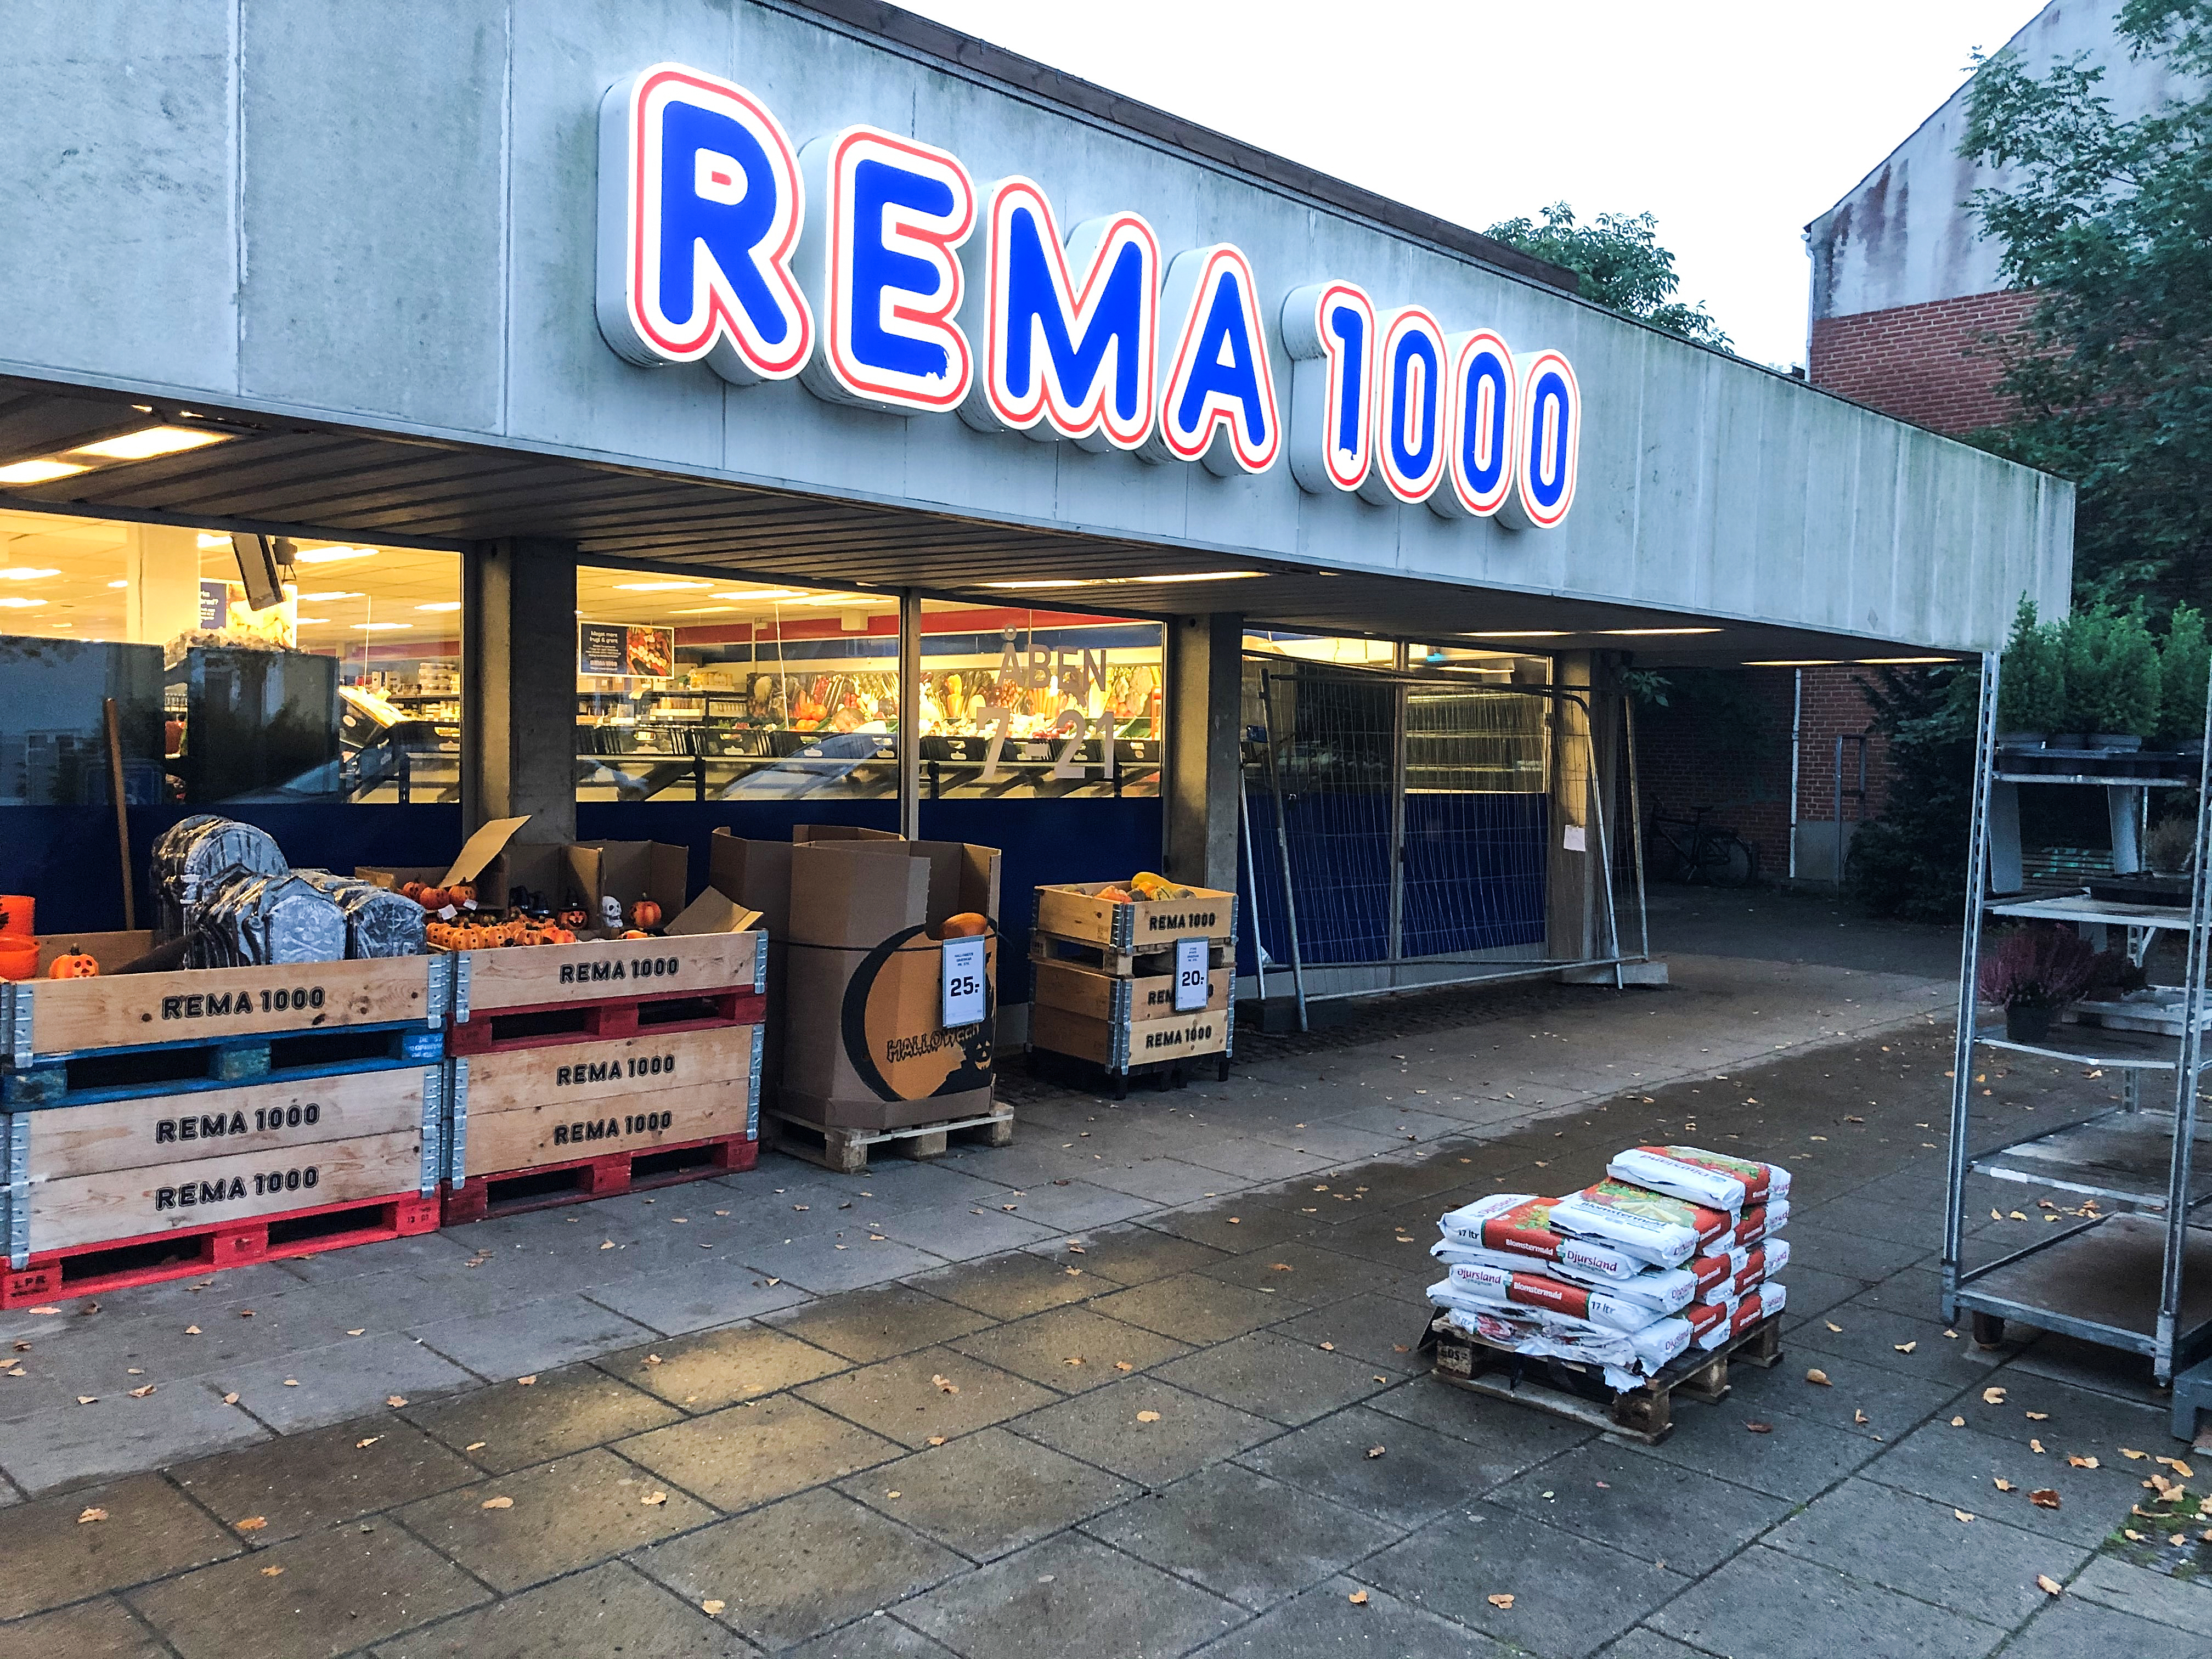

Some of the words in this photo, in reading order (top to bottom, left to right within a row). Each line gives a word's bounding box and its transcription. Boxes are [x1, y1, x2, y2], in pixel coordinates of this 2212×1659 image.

[627, 62, 1281, 474] REMA
[1316, 279, 1581, 528] 1000
[997, 624, 1107, 692] ÅBEN
[1149, 913, 1186, 931] REMA
[1189, 912, 1216, 928] 1000
[560, 960, 626, 984] REMA
[631, 957, 679, 979] 1000
[162, 991, 253, 1020] REMA
[259, 986, 325, 1013] 1000
[1146, 1029, 1182, 1049] REMA
[1185, 1025, 1212, 1043] 1000
[556, 1059, 623, 1086] REMA
[627, 1054, 675, 1078] 1000
[156, 1110, 248, 1144] REMA
[255, 1103, 320, 1132] 1000
[554, 1118, 620, 1146] REMA
[625, 1110, 673, 1135] 1000
[155, 1176, 247, 1211] REMA
[254, 1166, 319, 1196] 1000
[1469, 1230, 1480, 1239] ltr
[1505, 1238, 1554, 1256] Blomstermuld
[1567, 1250, 1618, 1272] Djursland
[1514, 1282, 1562, 1300] Blomstermuld
[1591, 1300, 1600, 1310] 17
[1603, 1302, 1616, 1315] ltr
